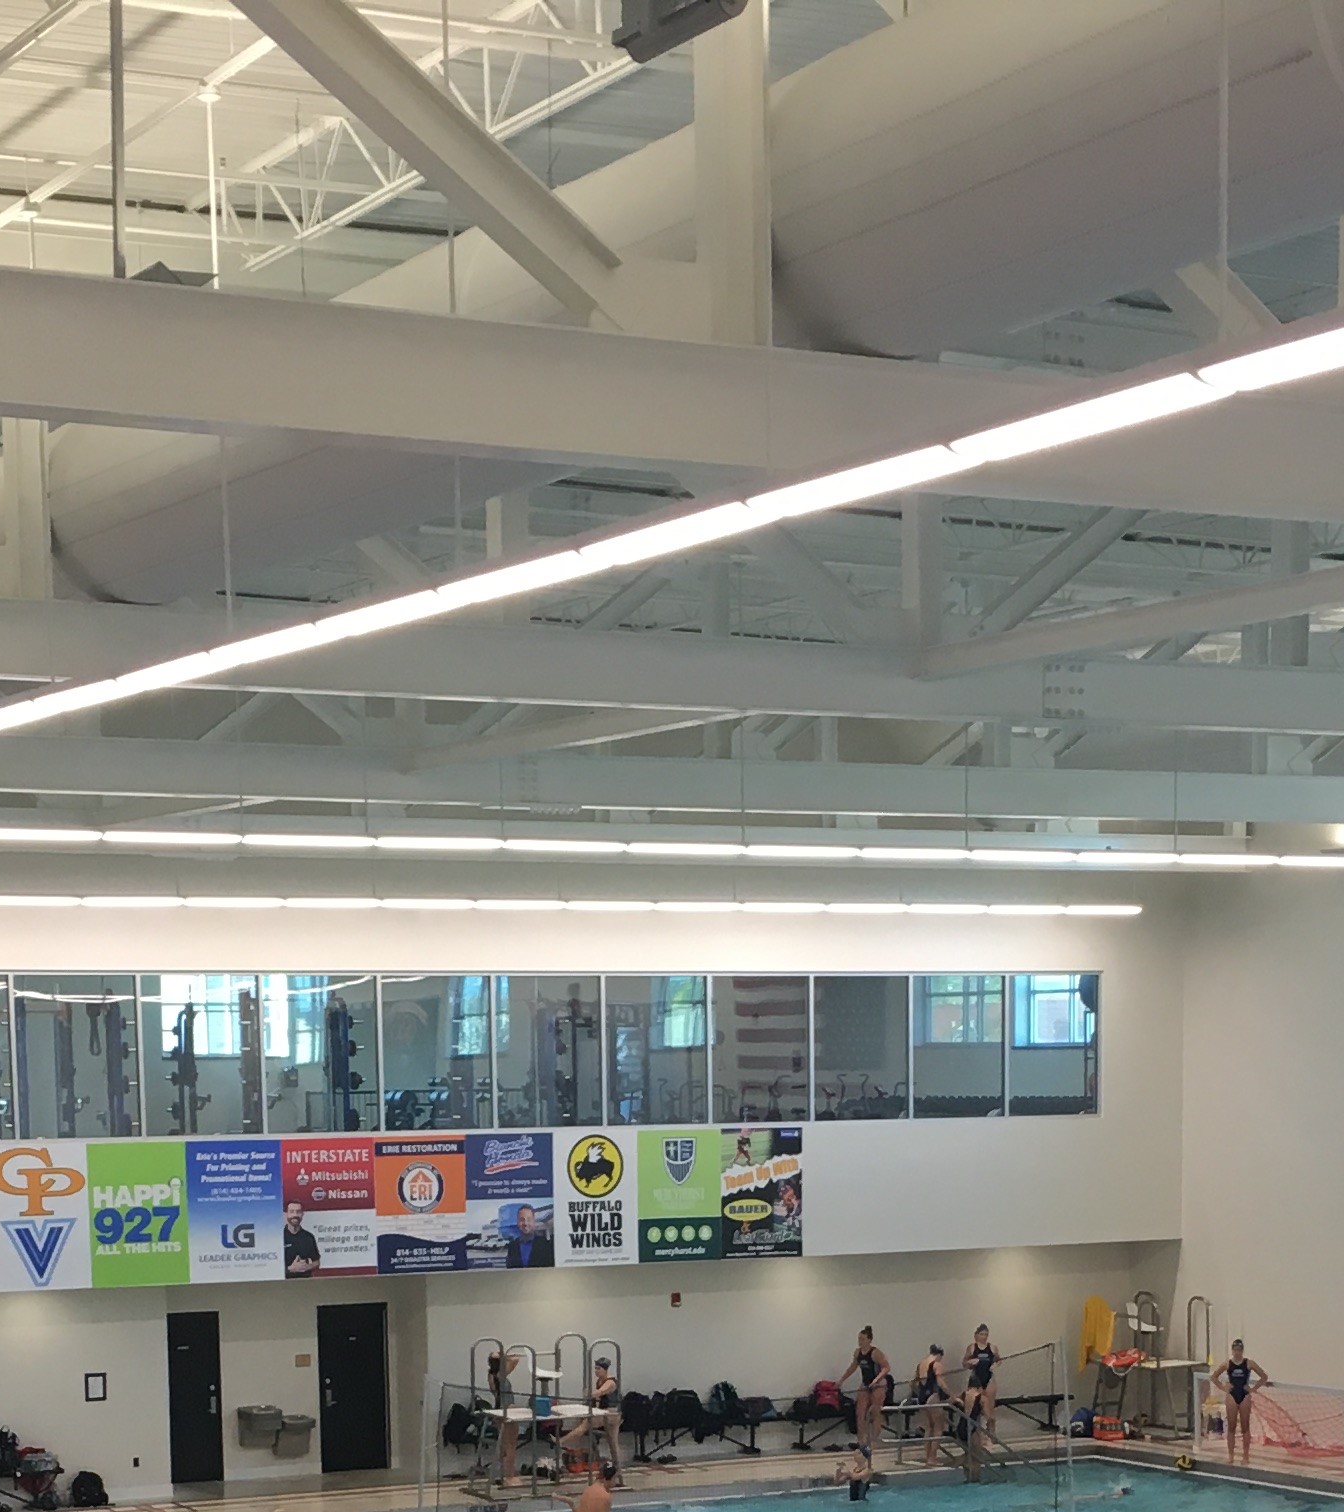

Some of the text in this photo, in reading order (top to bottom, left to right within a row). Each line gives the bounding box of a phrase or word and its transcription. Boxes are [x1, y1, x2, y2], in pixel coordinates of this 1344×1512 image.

[382, 1143, 458, 1154] ERIE RESTORATION
[196, 1151, 276, 1161] Erie's Premier Source
[286, 1148, 370, 1164] INTERSTATE
[206, 1162, 267, 1174] For Printing and
[201, 1173, 248, 1183] Promotional
[311, 1169, 369, 1182] Mitsubishi
[328, 1188, 369, 1200] Nissan
[409, 1183, 433, 1202] ERI
[568, 1200, 623, 1213] BUFFALO
[729, 1204, 768, 1215] BAUER
[93, 1205, 181, 1246] 927
[568, 1212, 623, 1233] WILD
[221, 1223, 256, 1249] LG
[317, 1233, 369, 1244] mileage and
[568, 1231, 623, 1249] WINGS
[0, 1216, 78, 1288] V
[95, 1239, 182, 1256] ALL THE HITS
[199, 1252, 278, 1263] LEADER GRAPHICS
